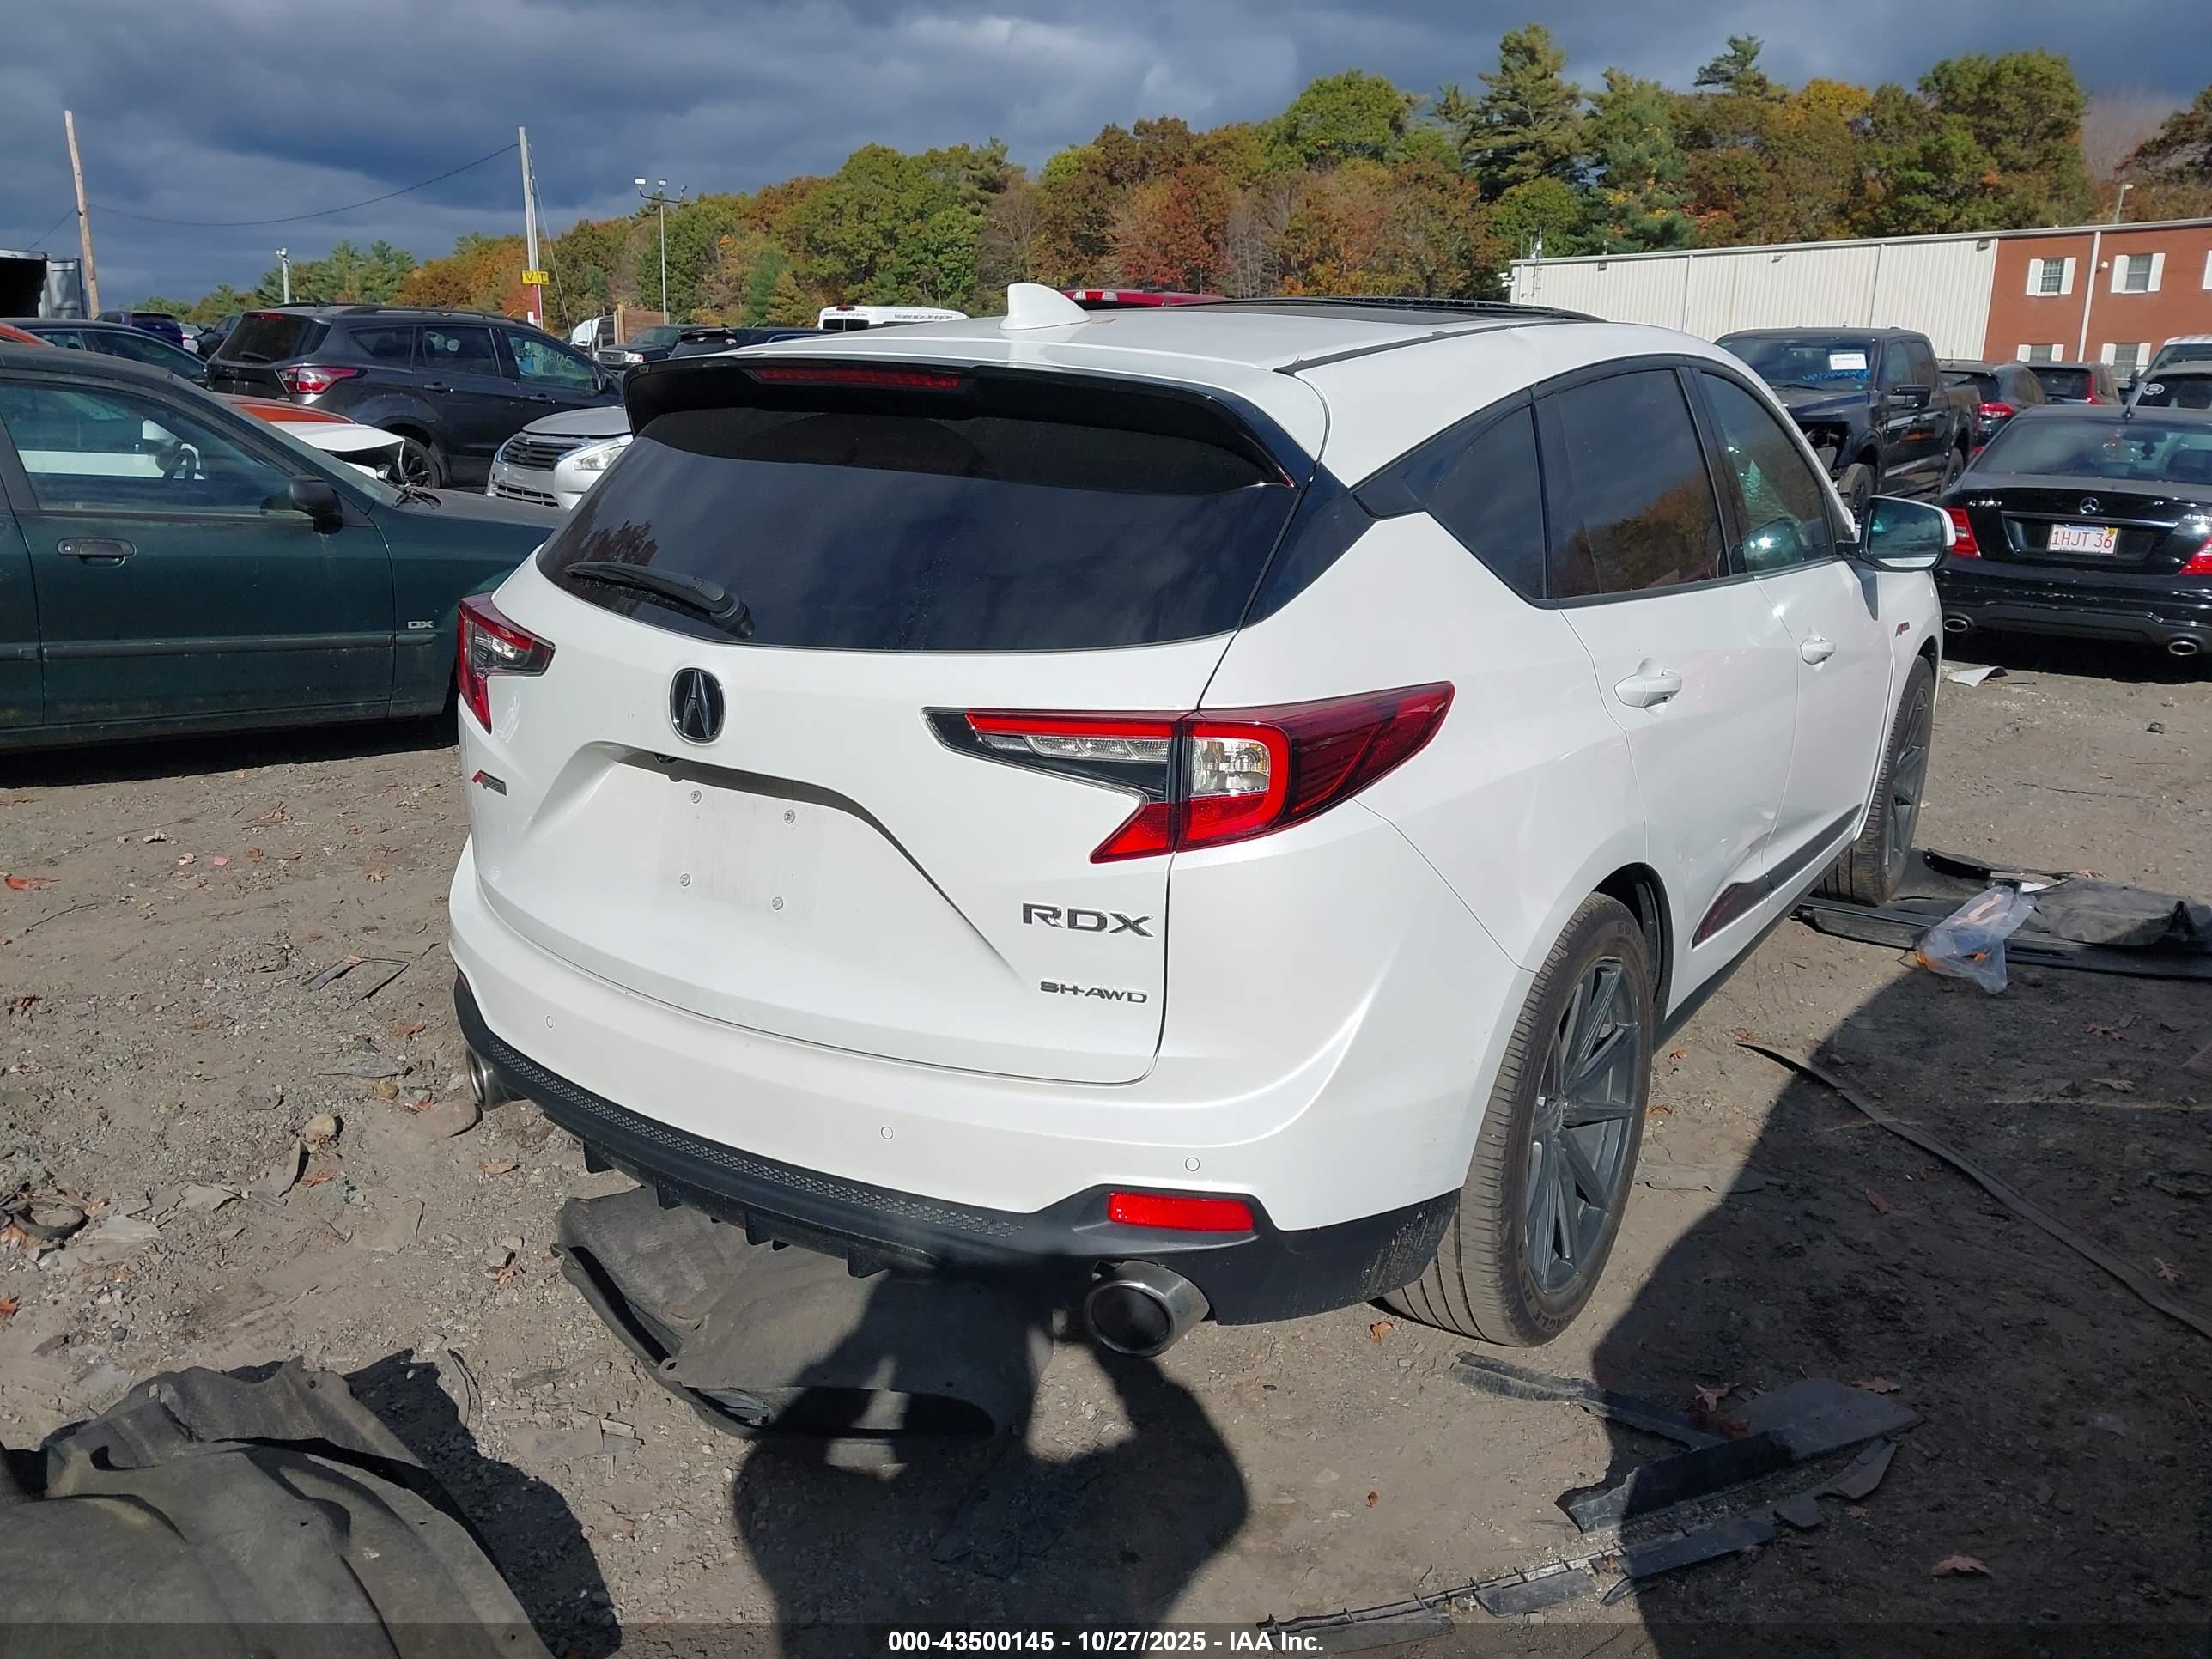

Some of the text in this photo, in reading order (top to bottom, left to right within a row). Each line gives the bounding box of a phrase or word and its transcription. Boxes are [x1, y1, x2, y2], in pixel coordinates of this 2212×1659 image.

[2051, 530, 2113, 549] 1HJT 36
[407, 620, 434, 629] DX
[1022, 902, 1154, 938] RDX
[1040, 981, 1148, 1003] SH-AWD
